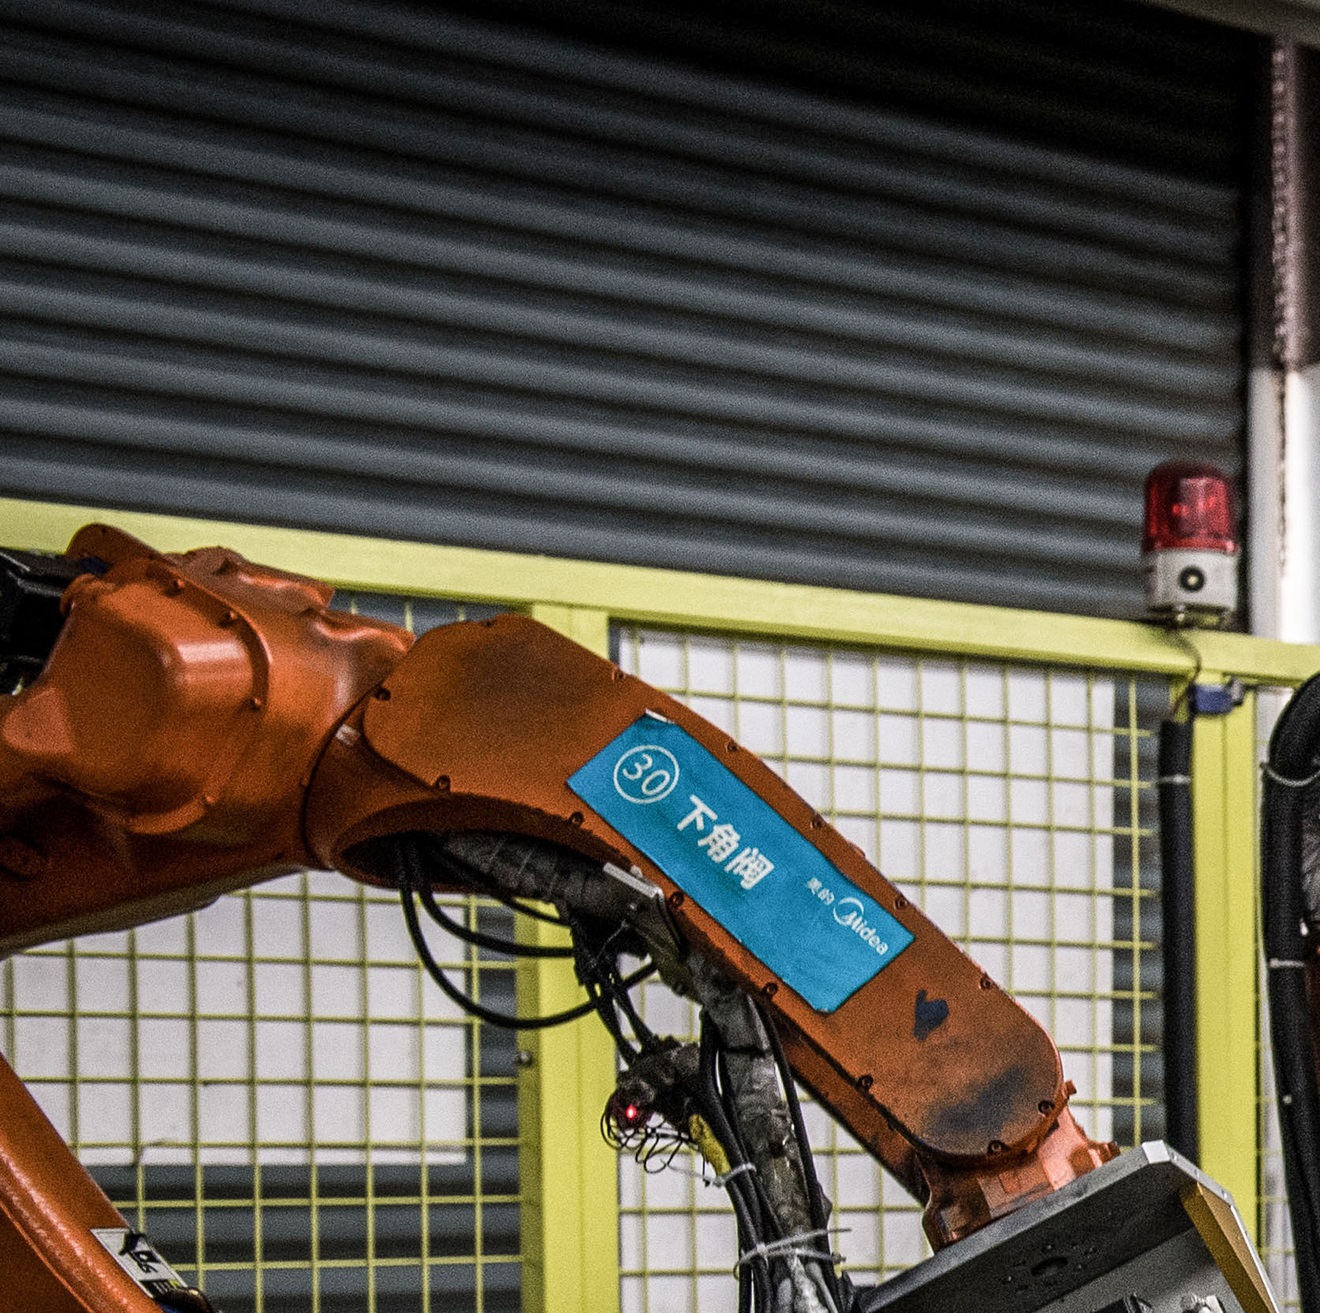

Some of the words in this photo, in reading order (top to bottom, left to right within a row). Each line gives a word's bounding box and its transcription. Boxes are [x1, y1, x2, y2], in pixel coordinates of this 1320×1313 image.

[621, 753, 671, 797] 30
[676, 793, 776, 890] 下角阀
[833, 896, 889, 956] Midea
